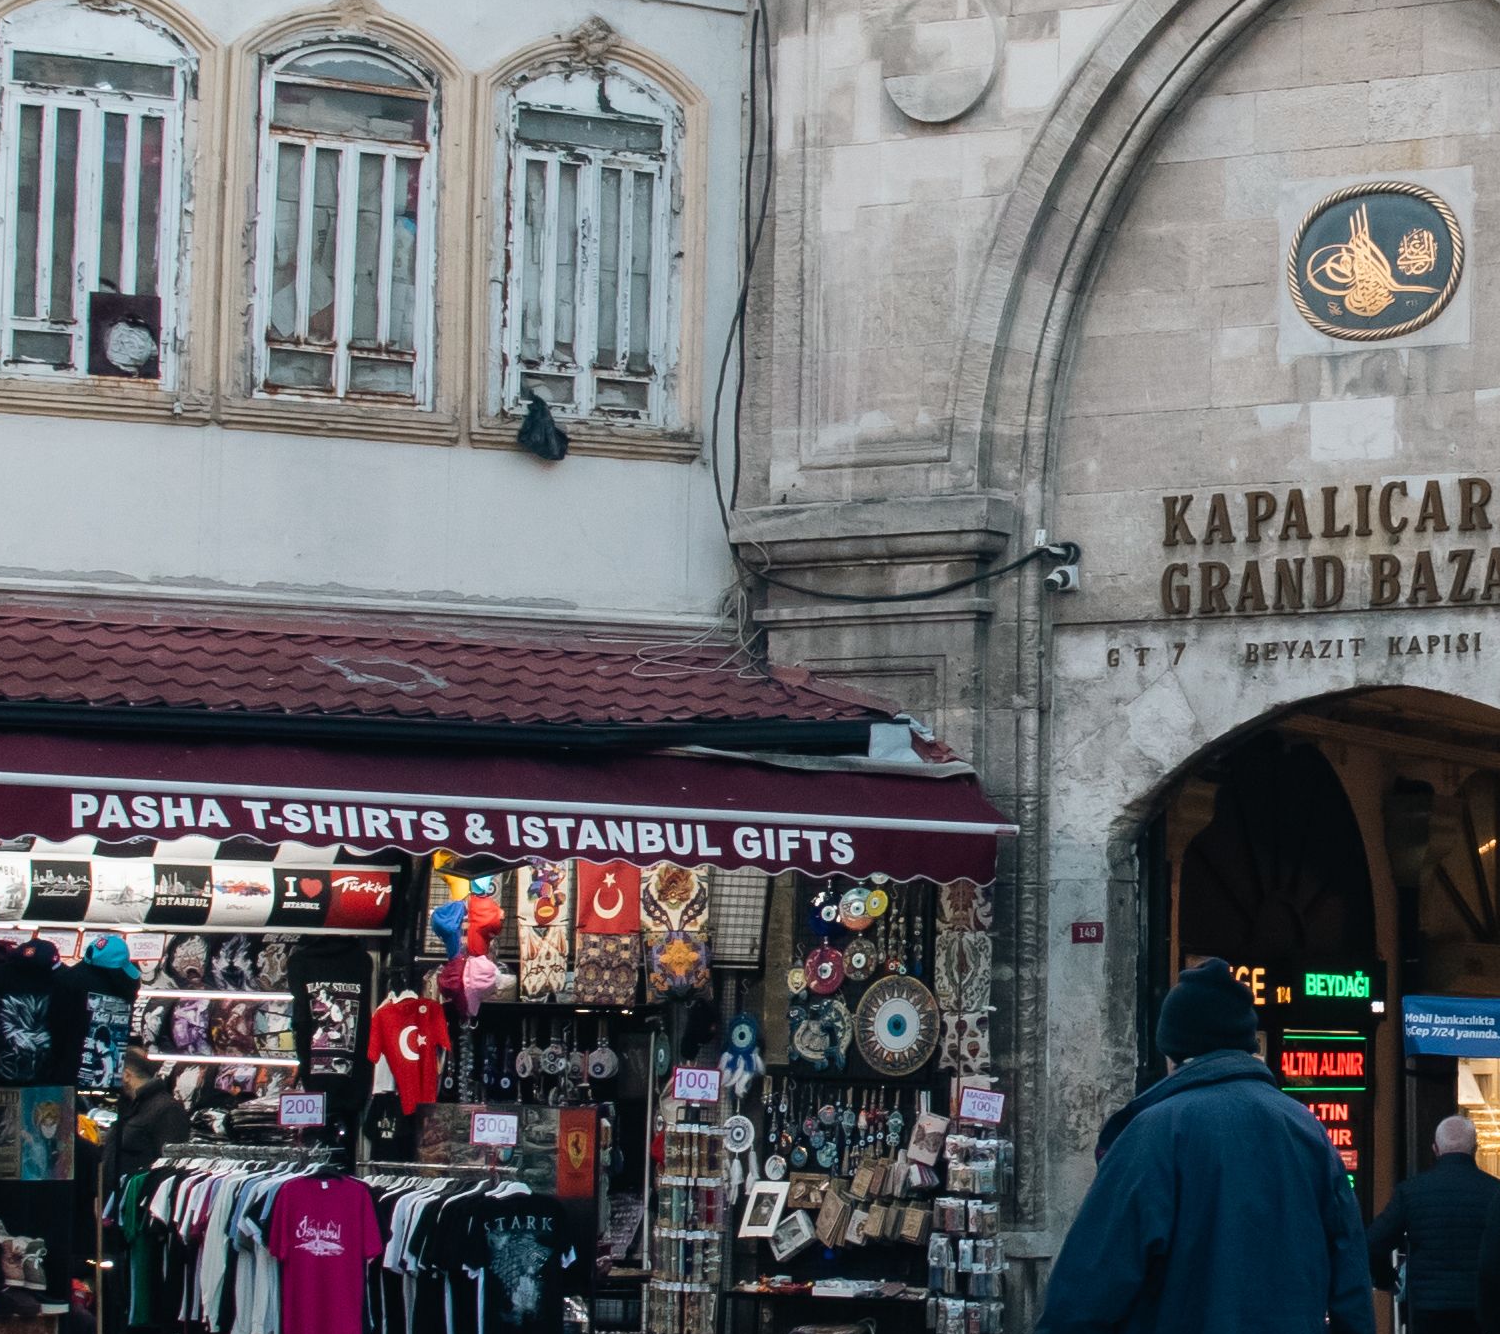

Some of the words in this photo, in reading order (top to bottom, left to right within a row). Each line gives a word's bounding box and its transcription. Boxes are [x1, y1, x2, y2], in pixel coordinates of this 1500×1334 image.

[1161, 554, 1346, 615] GRAND
[1244, 637, 1366, 665] BEYAZIT
[1388, 632, 1483, 656] KAPISI
[71, 793, 230, 829] PASHA
[241, 800, 450, 842] T-SHIRTS
[464, 813, 495, 846] &
[506, 814, 722, 857] ISTANBUL
[732, 826, 855, 865] GIFTS
[156, 896, 209, 908] ISTANBUL
[331, 875, 393, 906] Türkiye
[1305, 970, 1370, 998] BEYDAĞI
[1404, 1012, 1433, 1024] Mobil
[1433, 1013, 1496, 1026] bankacılıkta
[1431, 1026, 1455, 1038] 7/24
[1455, 1029, 1500, 1040] yanında.
[1281, 1051, 1318, 1076] ALTIN
[1319, 1051, 1364, 1077] ALINIR
[483, 1215, 556, 1234] STARK
